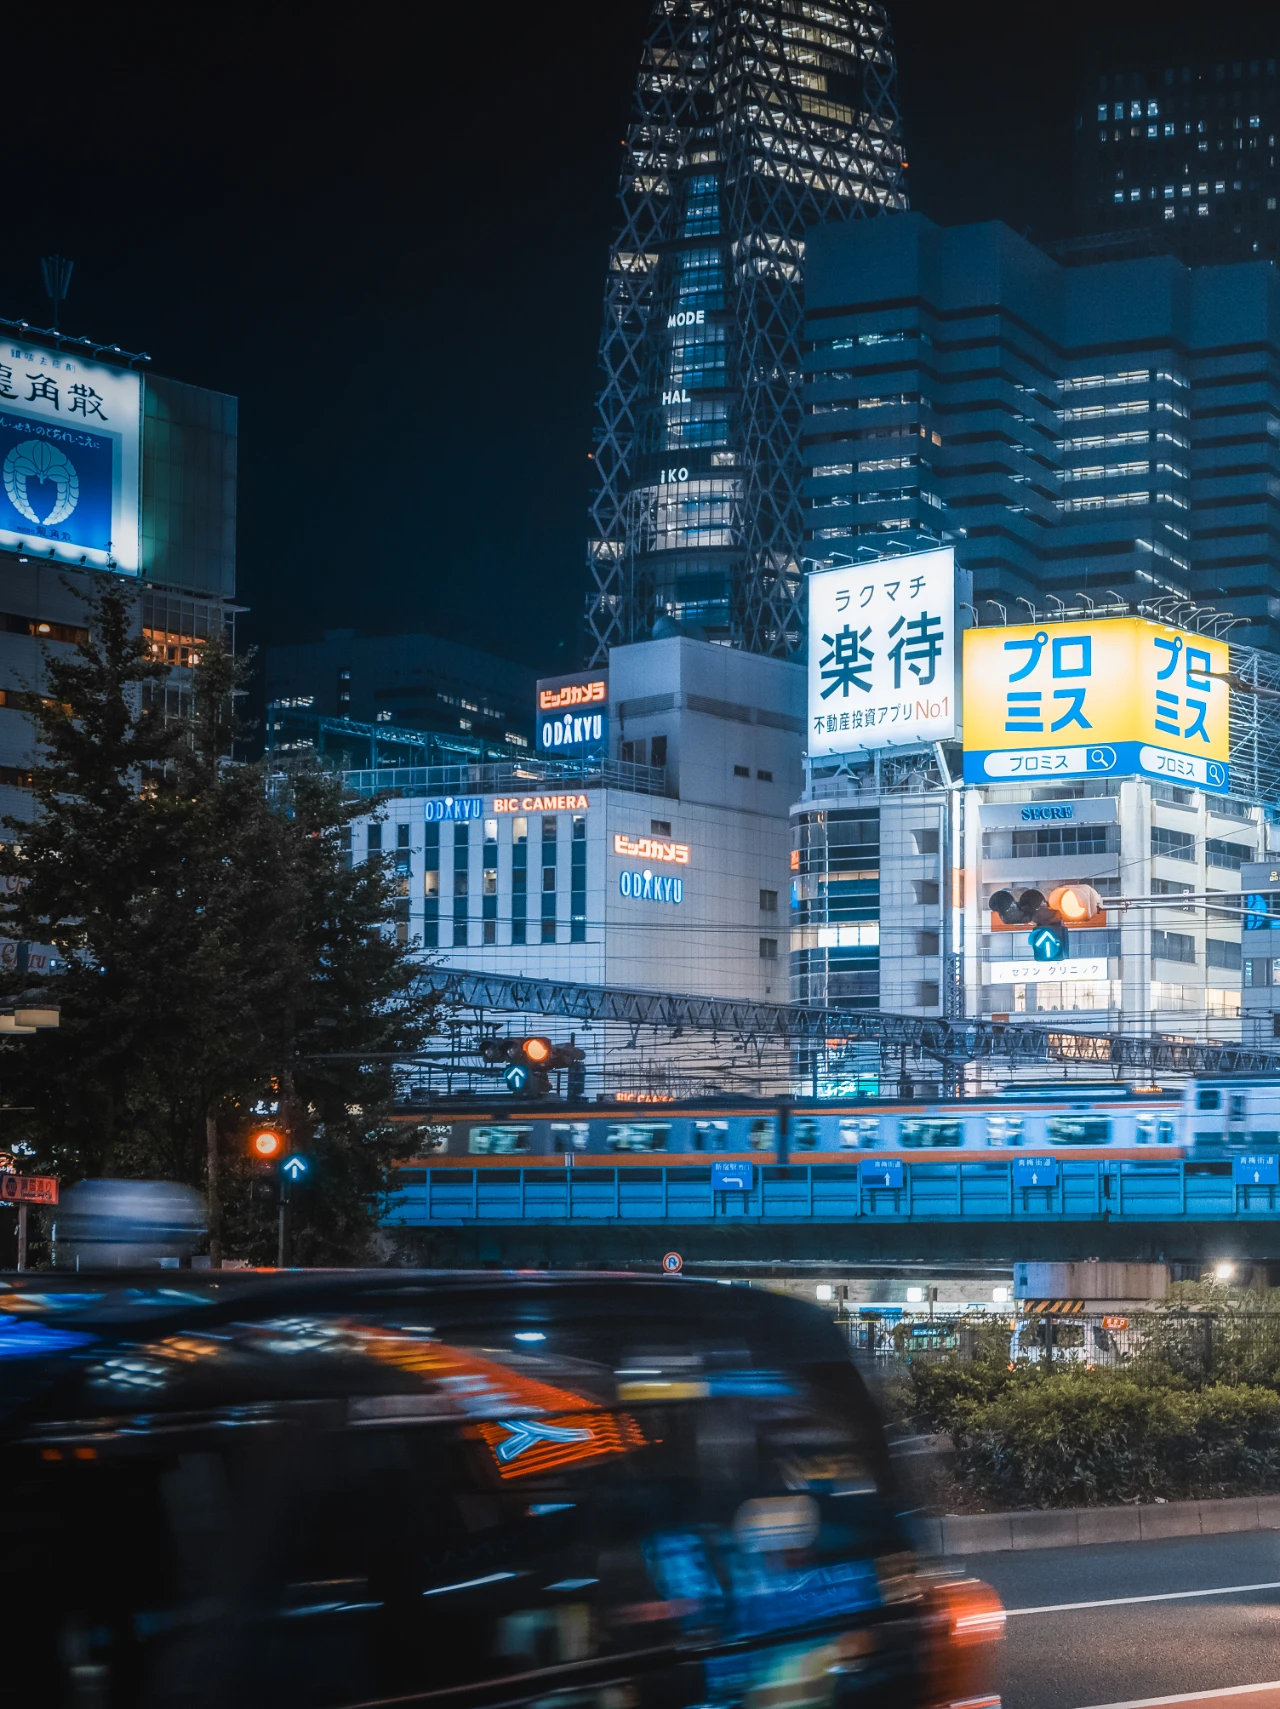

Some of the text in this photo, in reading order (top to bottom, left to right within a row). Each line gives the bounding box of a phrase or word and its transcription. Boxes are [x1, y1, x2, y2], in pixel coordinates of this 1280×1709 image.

[667, 310, 705, 328] MODE
[662, 388, 691, 405] HAL
[835, 575, 926, 612] ラクマチ
[818, 610, 944, 701] 楽待
[1004, 631, 1092, 683] プロ
[1154, 636, 1211, 693] プロ
[540, 681, 606, 709] ビックカメラ
[1005, 687, 1093, 732] ミス
[543, 713, 602, 748] ODAKYU
[1154, 689, 1211, 743] ミス
[1009, 755, 1069, 772] プロミス
[1156, 755, 1196, 776] プロミス
[425, 797, 481, 820] ODAKYU
[493, 795, 588, 812] BIC CAMERA
[614, 834, 690, 864] ビックカメラ
[620, 869, 683, 904] ODAKYU
